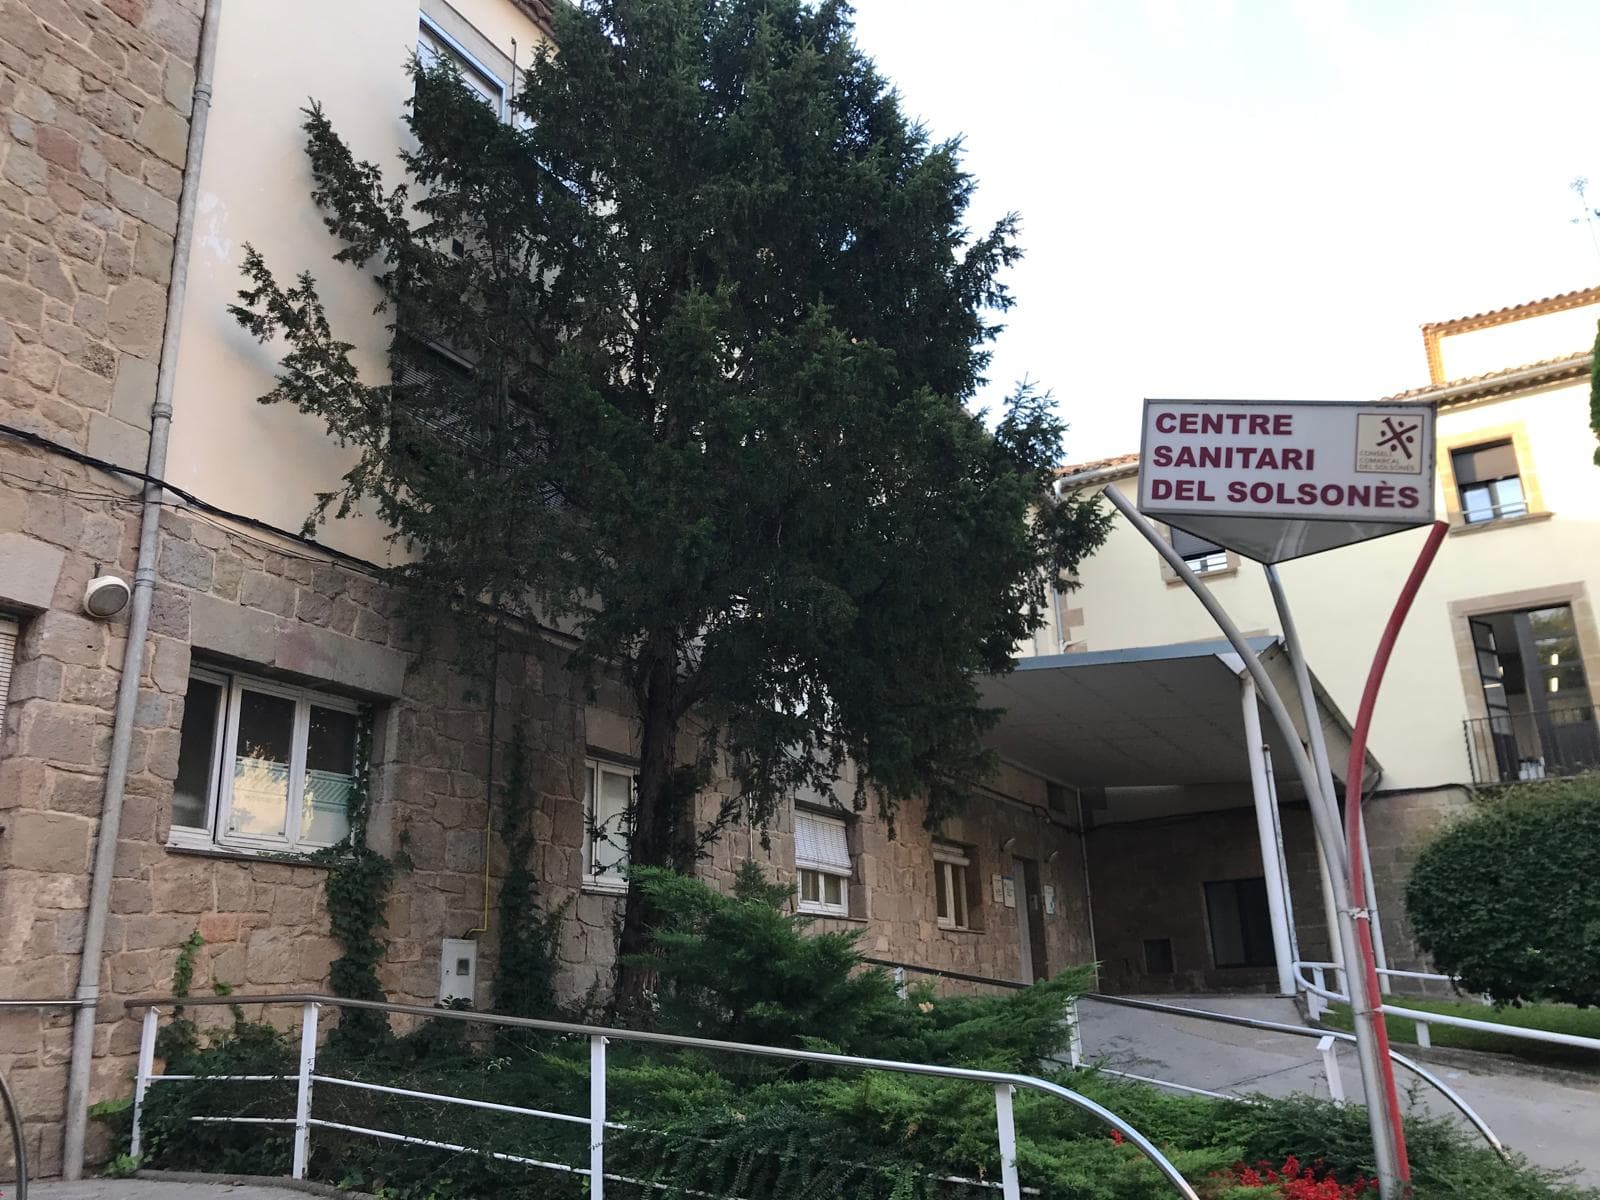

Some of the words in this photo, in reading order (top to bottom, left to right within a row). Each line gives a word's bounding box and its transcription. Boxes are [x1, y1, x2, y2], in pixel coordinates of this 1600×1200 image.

[1155, 412, 1293, 435] CENTRE
[1153, 445, 1315, 471] SANITARI
[1151, 479, 1216, 502] DEL
[1226, 480, 1420, 508] SOLSONÈS
